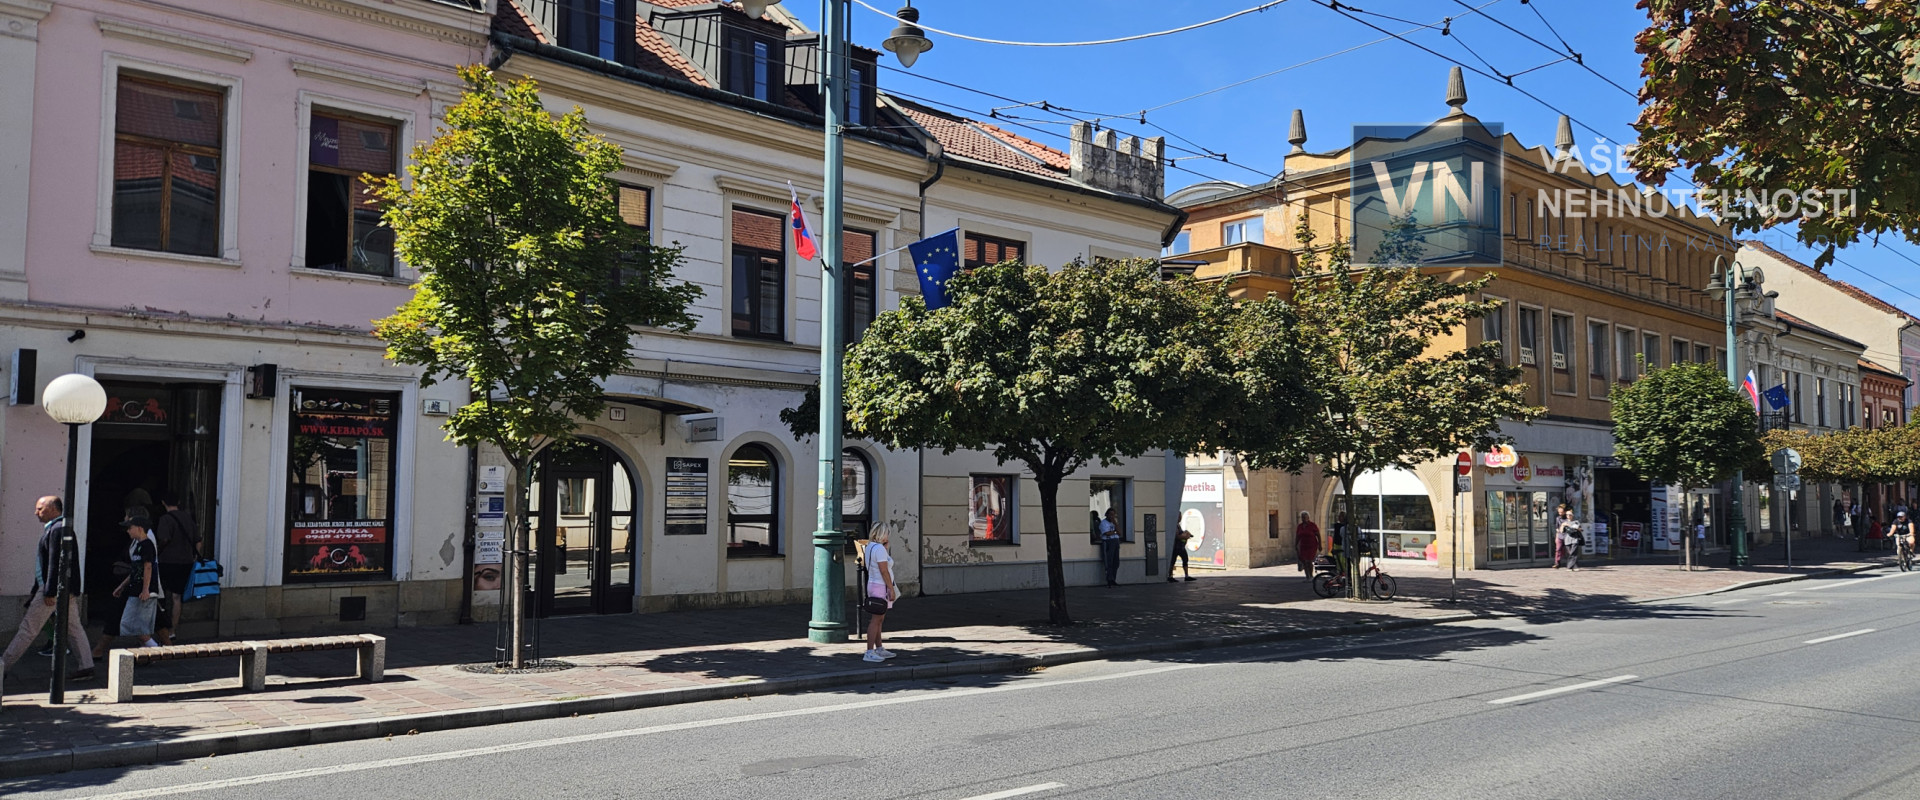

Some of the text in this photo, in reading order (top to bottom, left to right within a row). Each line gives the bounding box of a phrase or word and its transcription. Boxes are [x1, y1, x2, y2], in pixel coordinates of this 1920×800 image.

[300, 425, 384, 435] WWW.KEBAPO.SK
[1489, 453, 1511, 462] teta
[1516, 465, 1529, 476] teta
